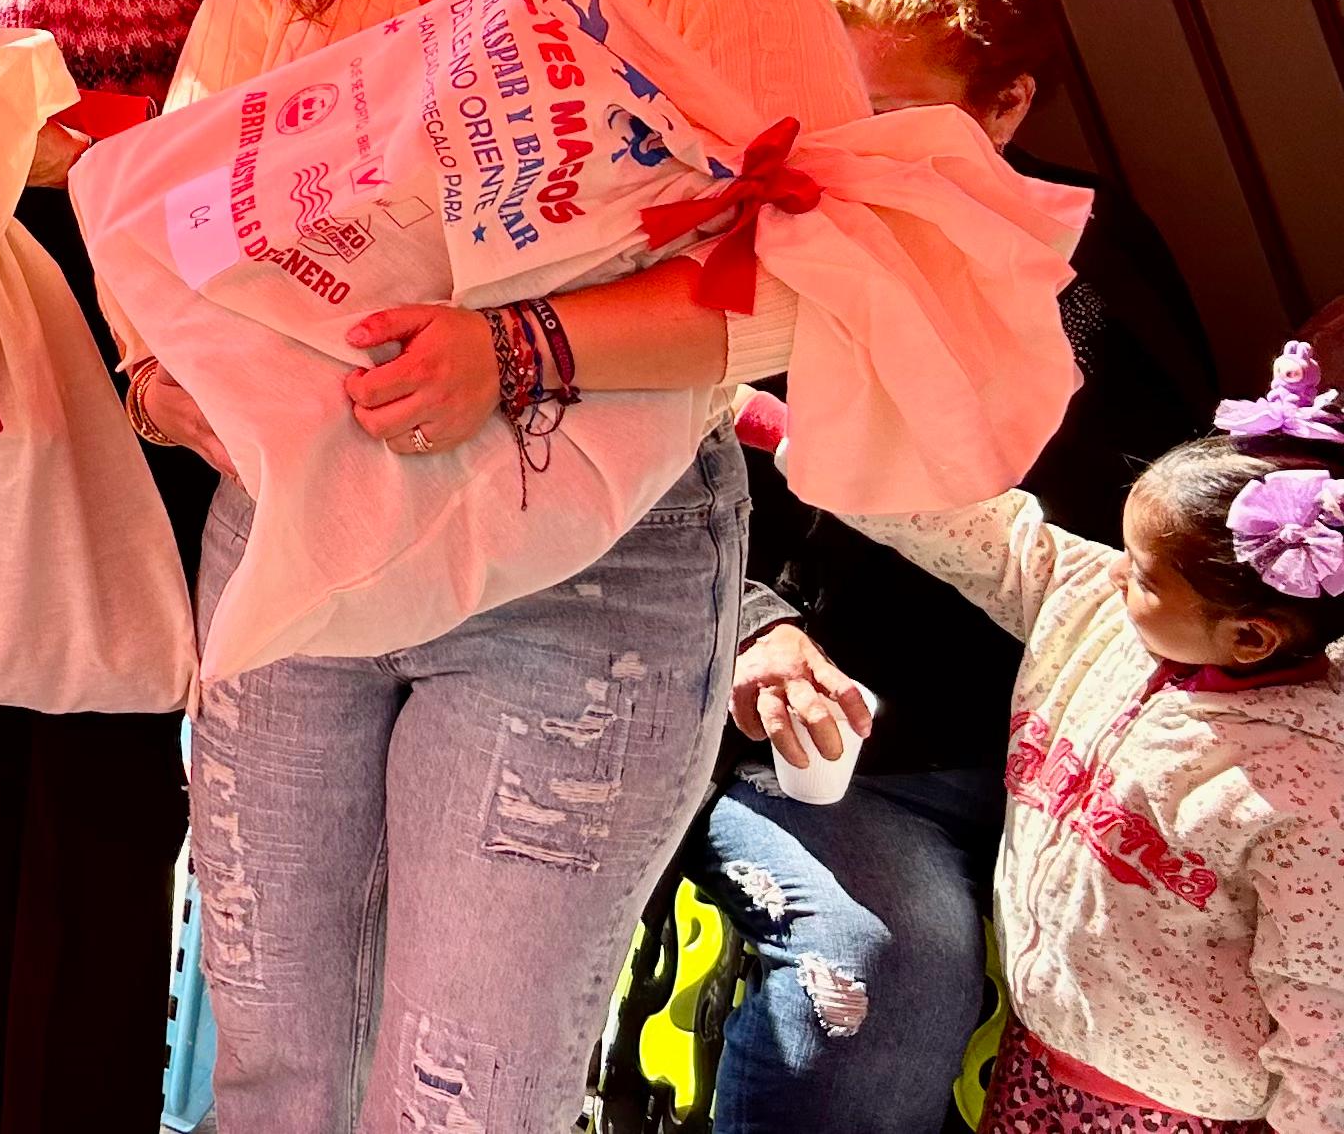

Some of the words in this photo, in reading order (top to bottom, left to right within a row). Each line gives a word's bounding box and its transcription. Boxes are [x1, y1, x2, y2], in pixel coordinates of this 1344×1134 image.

[239, 90, 268, 149] ABRIR
[422, 99, 457, 168] REGALO
[506, 105, 534, 124] Y
[230, 148, 259, 199] HASTA
[458, 95, 506, 215] ORIENTE
[189, 205, 211, 230] 04
[231, 195, 257, 223] EL
[237, 220, 261, 239] 6
